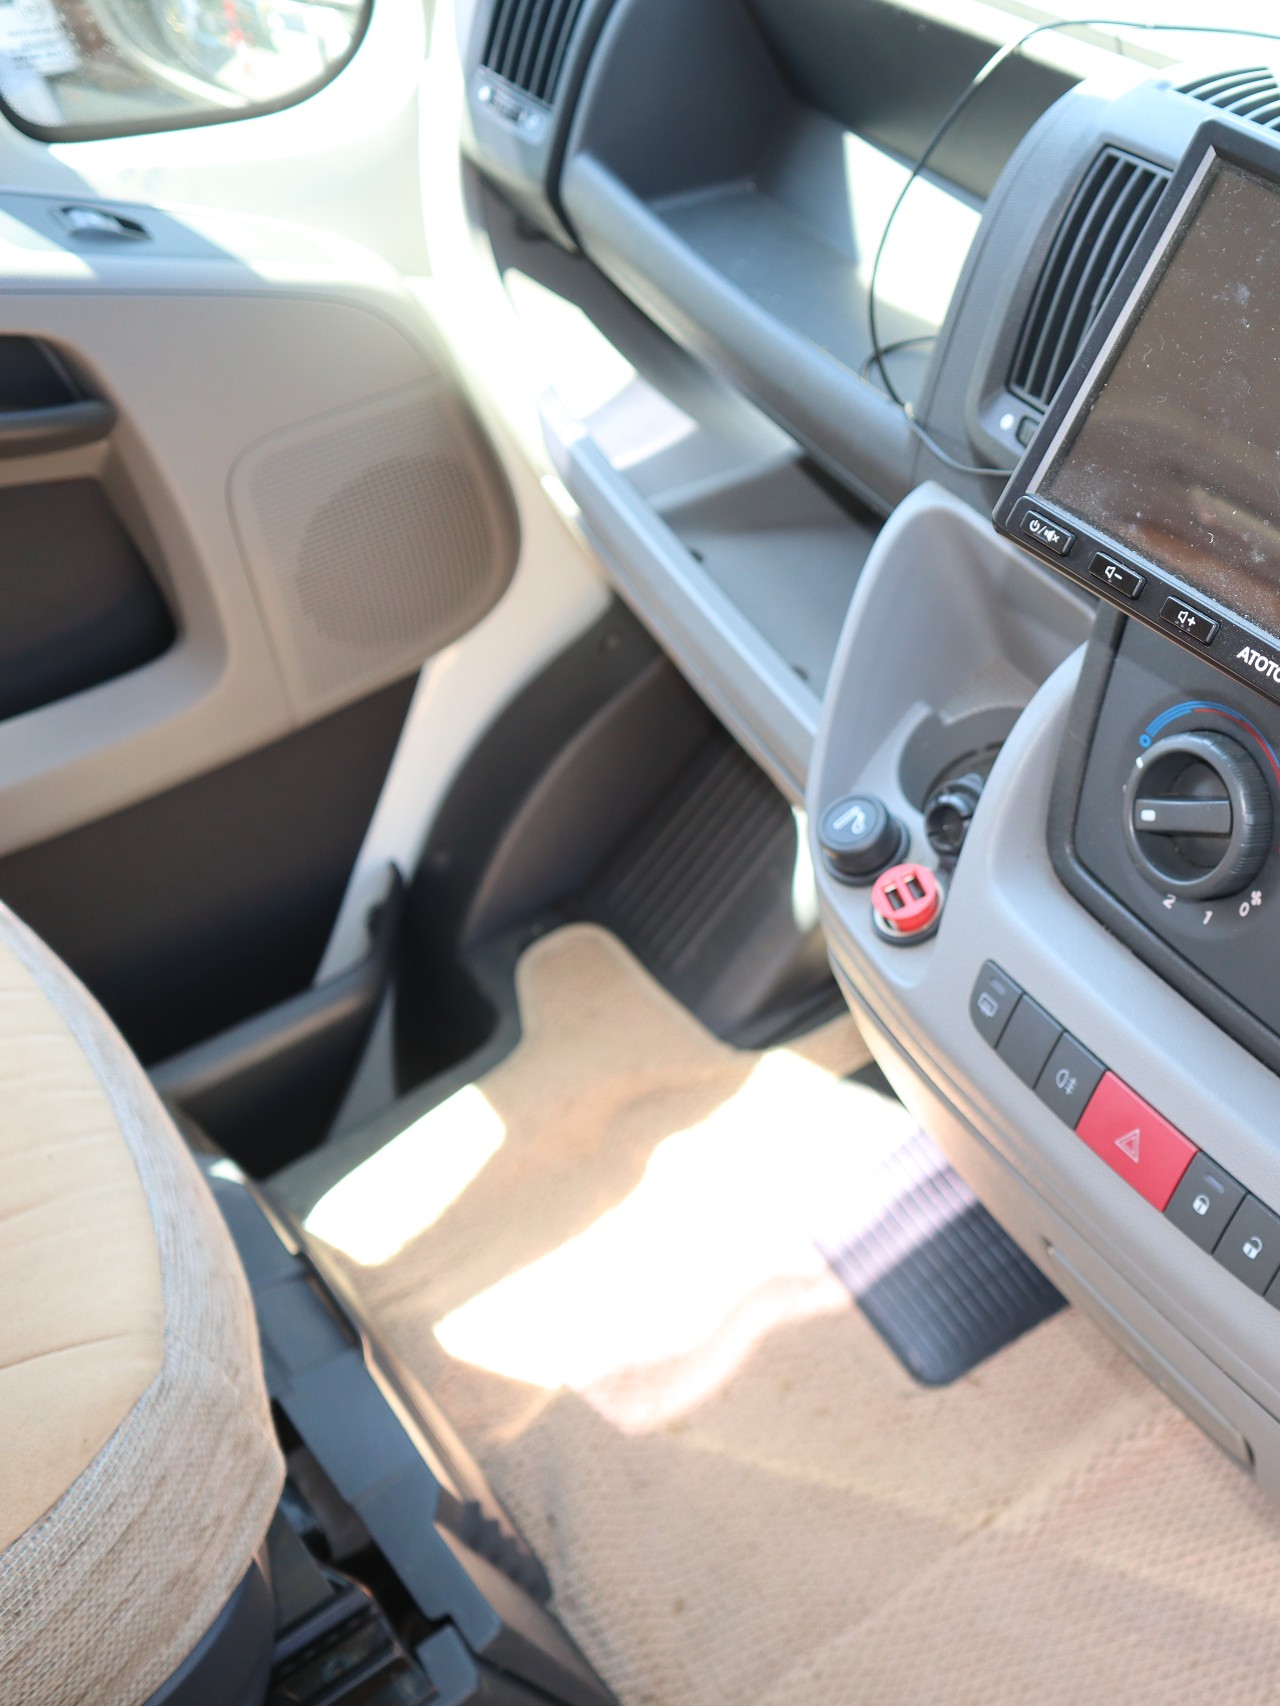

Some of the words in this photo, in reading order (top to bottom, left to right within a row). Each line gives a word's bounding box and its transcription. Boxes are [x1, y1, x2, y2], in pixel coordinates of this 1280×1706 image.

[1162, 893, 1177, 910] 2
[1238, 901, 1250, 917] 0
[1202, 910, 1213, 925] 1
